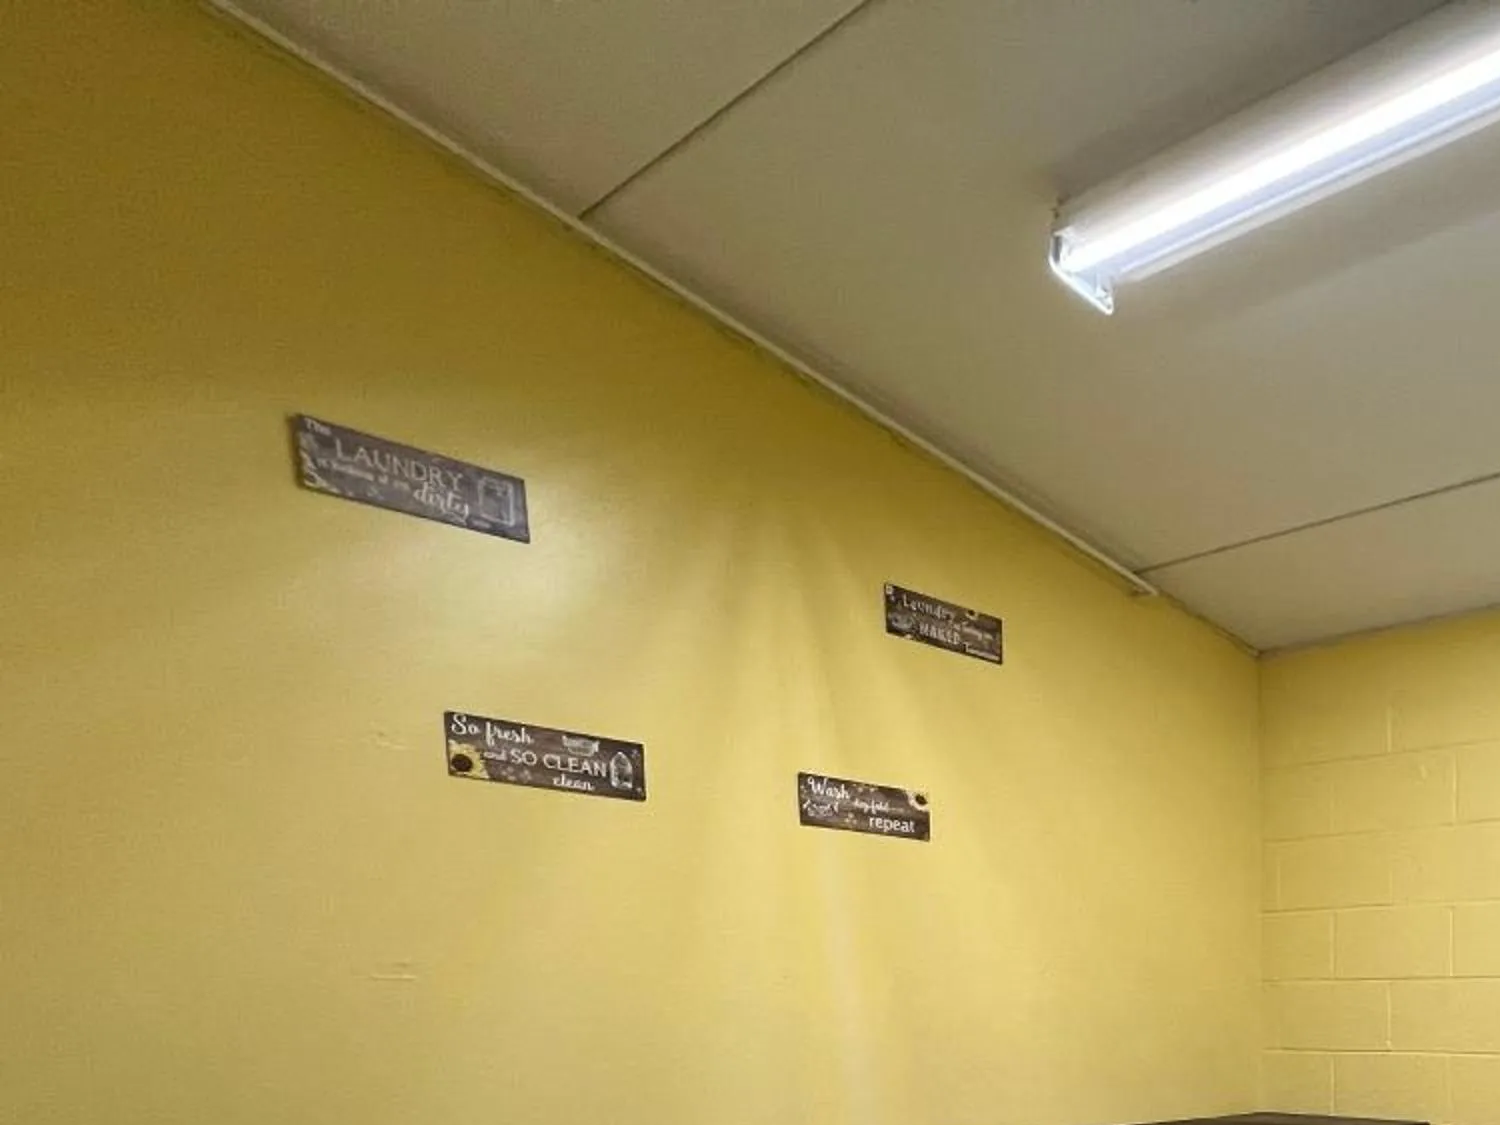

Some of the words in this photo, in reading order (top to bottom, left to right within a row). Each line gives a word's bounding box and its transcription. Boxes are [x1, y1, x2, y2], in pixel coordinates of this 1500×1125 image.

[334, 437, 465, 492] LAUNDRY
[412, 481, 470, 526] dirty
[450, 714, 480, 736] So
[484, 721, 535, 747] fresh
[510, 748, 538, 766] SO
[543, 754, 608, 778] CLEAN
[552, 773, 596, 791] clean
[807, 775, 851, 800] Wash
[869, 816, 916, 833] repeat
